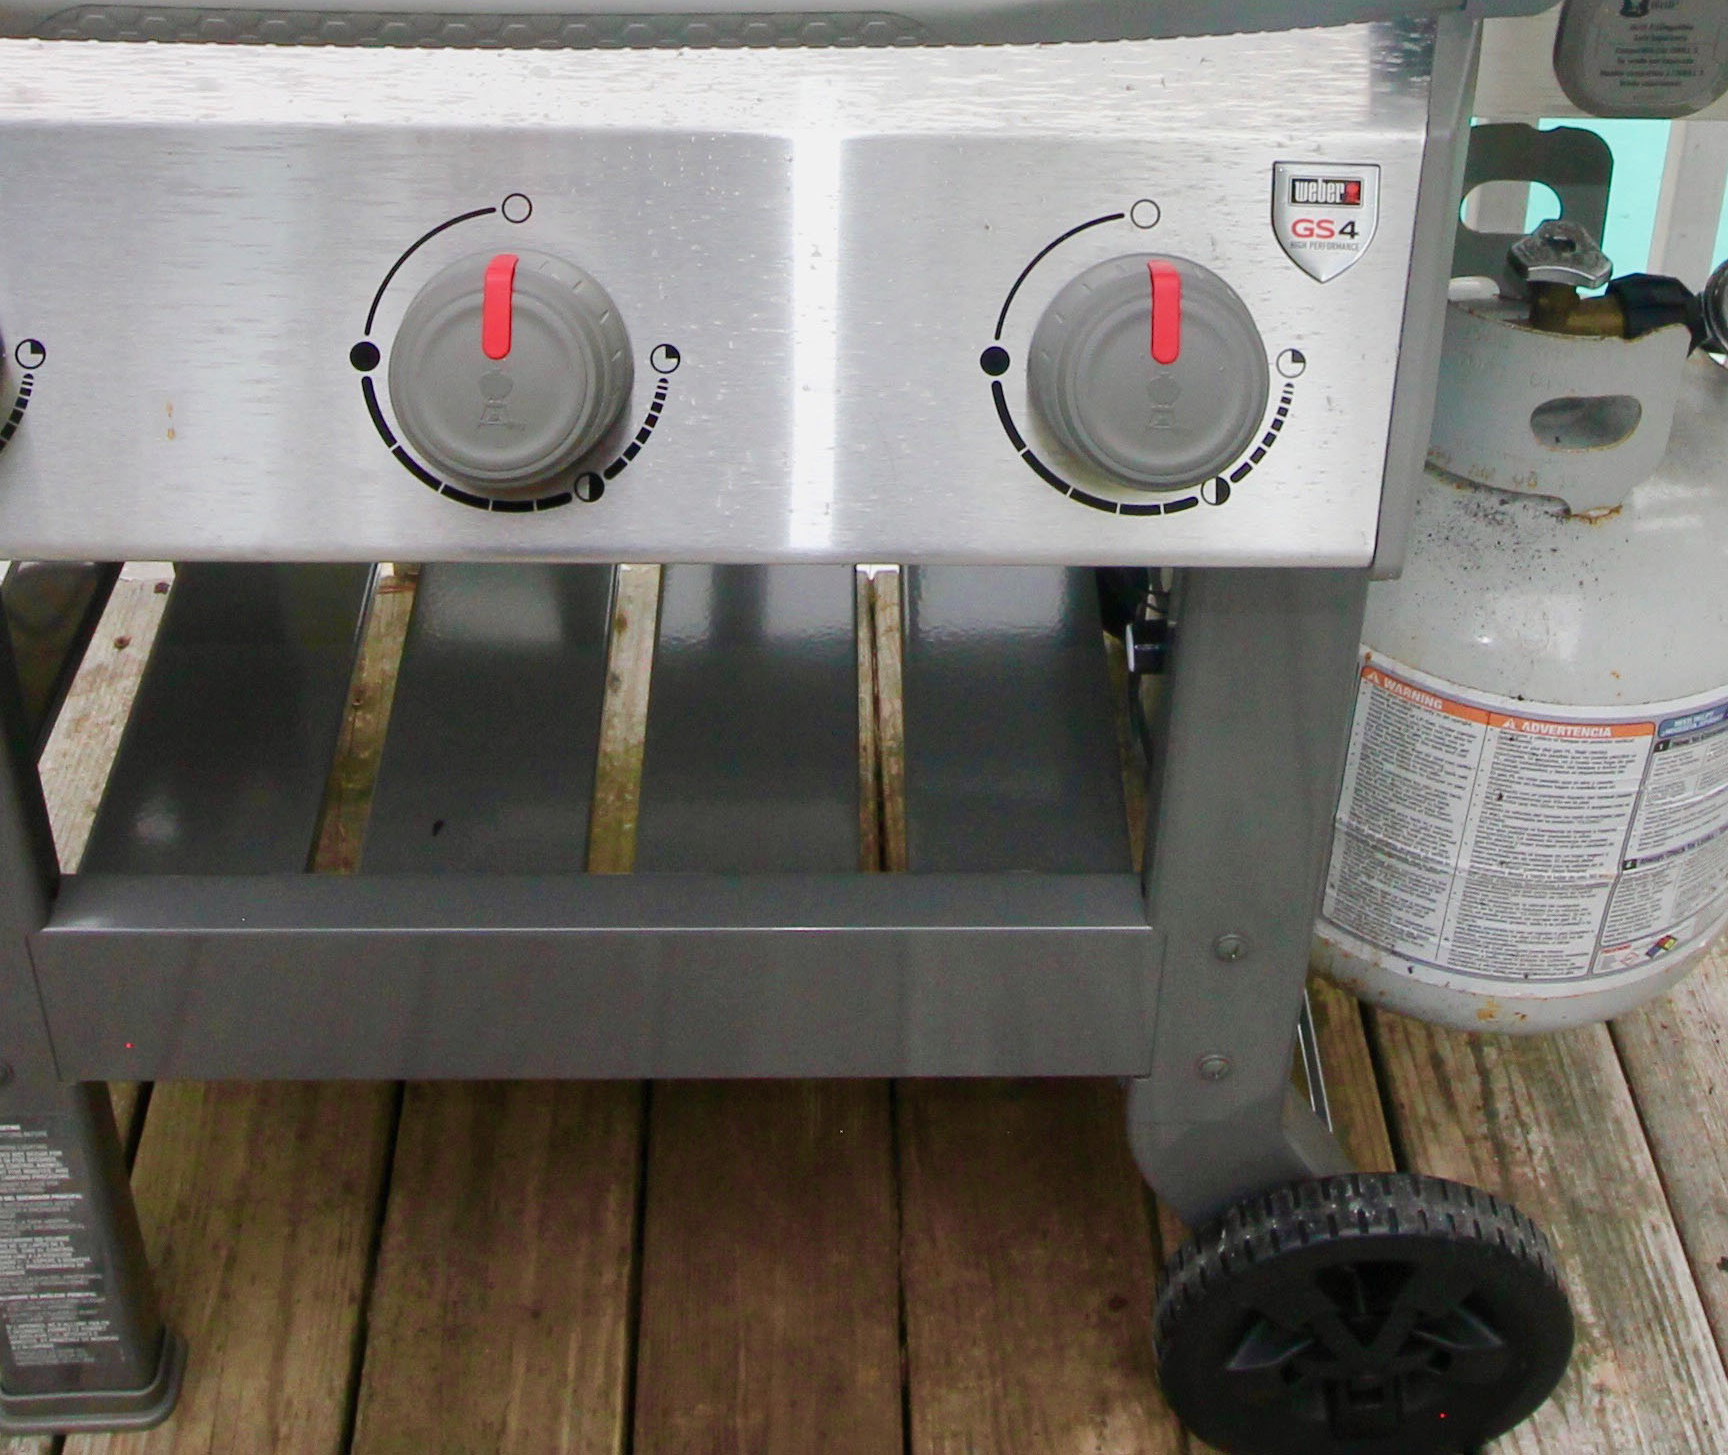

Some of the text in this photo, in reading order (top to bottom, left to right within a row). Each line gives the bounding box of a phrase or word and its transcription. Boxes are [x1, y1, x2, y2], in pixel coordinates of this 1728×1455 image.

[1294, 177, 1346, 203] weber
[1383, 677, 1443, 710] WARNING
[1522, 720, 1612, 737] ADVERTENCIA
